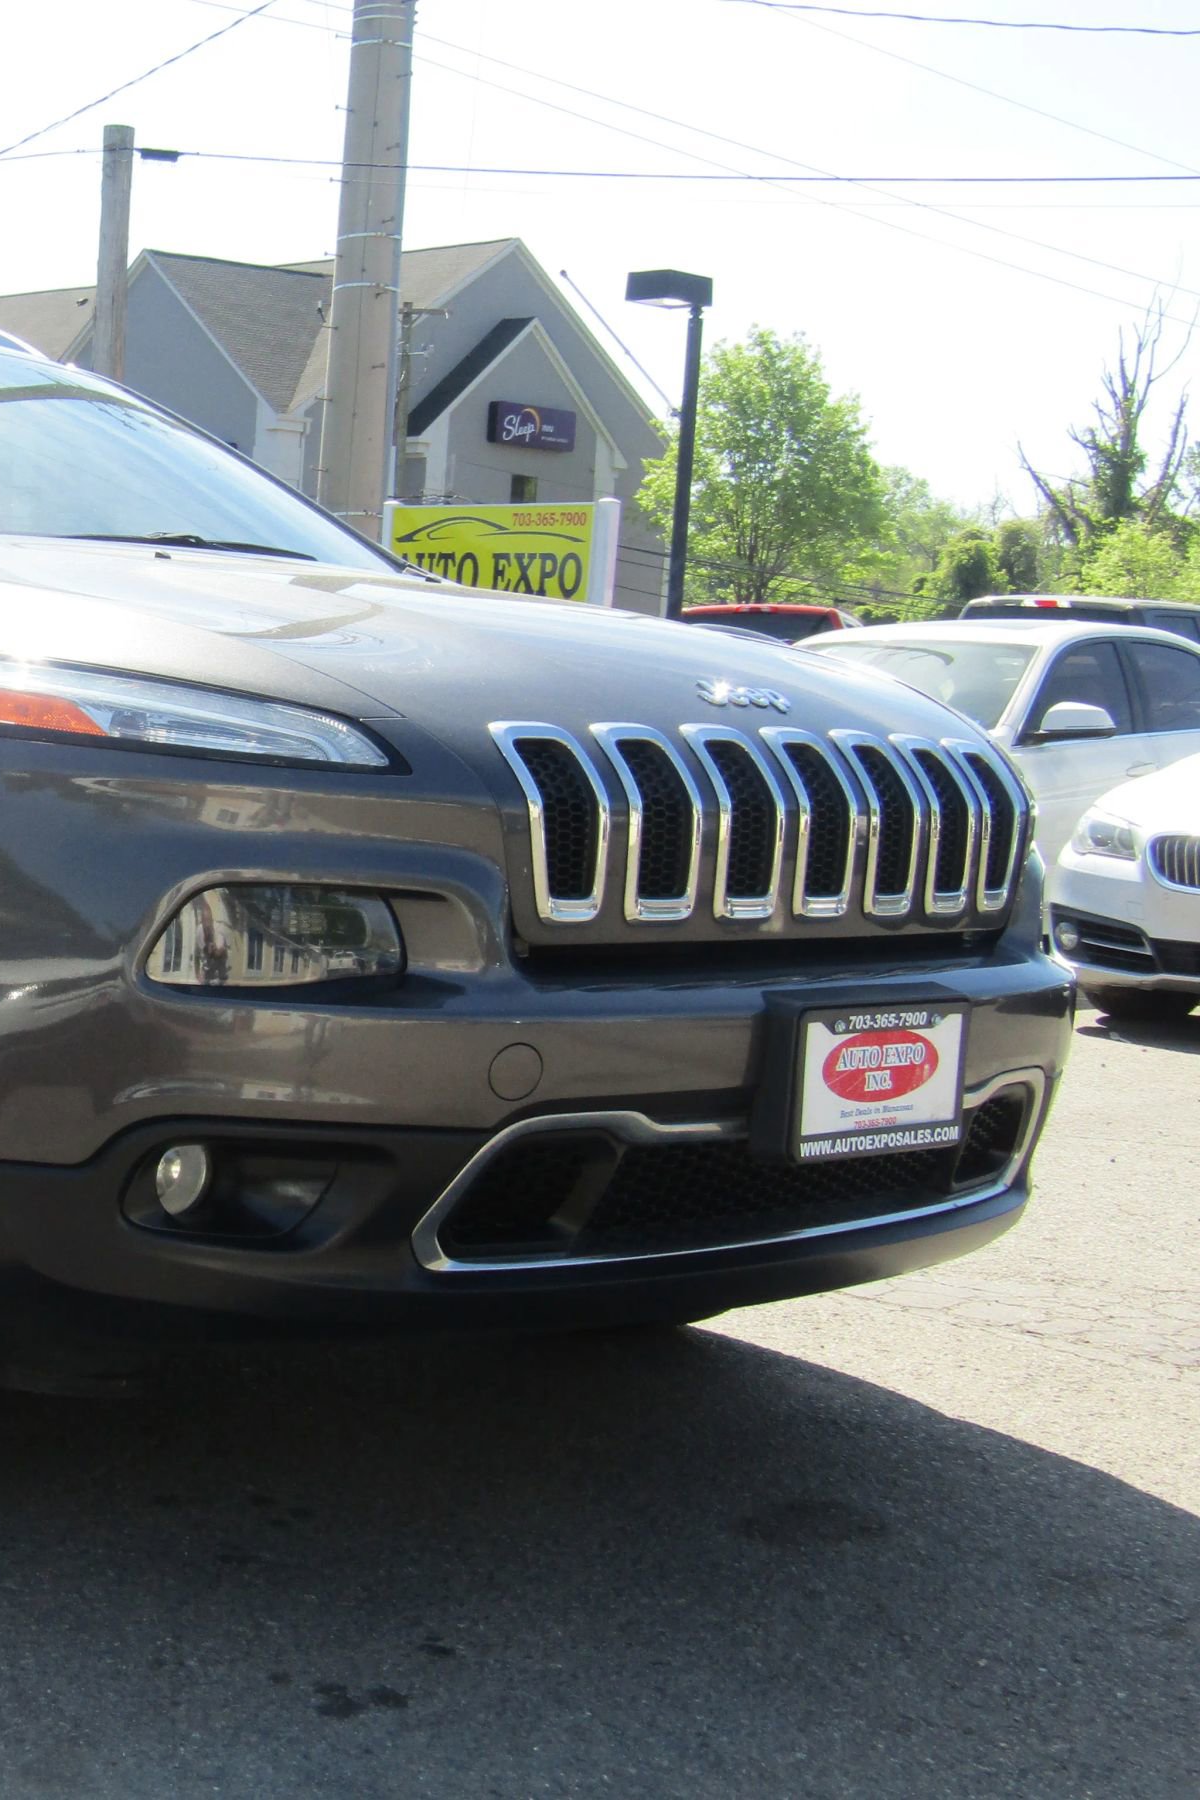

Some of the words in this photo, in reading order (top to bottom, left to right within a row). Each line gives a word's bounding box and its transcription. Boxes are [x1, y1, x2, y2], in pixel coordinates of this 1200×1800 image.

[503, 414, 536, 442] Sleep
[512, 511, 587, 527] 703-365-7900
[491, 552, 583, 600] EXPO
[695, 679, 791, 714] Jeep
[848, 1011, 927, 1031] 703-365-7900
[837, 1046, 881, 1071] AUTO
[882, 1043, 926, 1068] EXPO
[864, 1070, 893, 1091] INC.
[800, 1126, 959, 1158] WWW.AUTOEXPOSALES.COM
